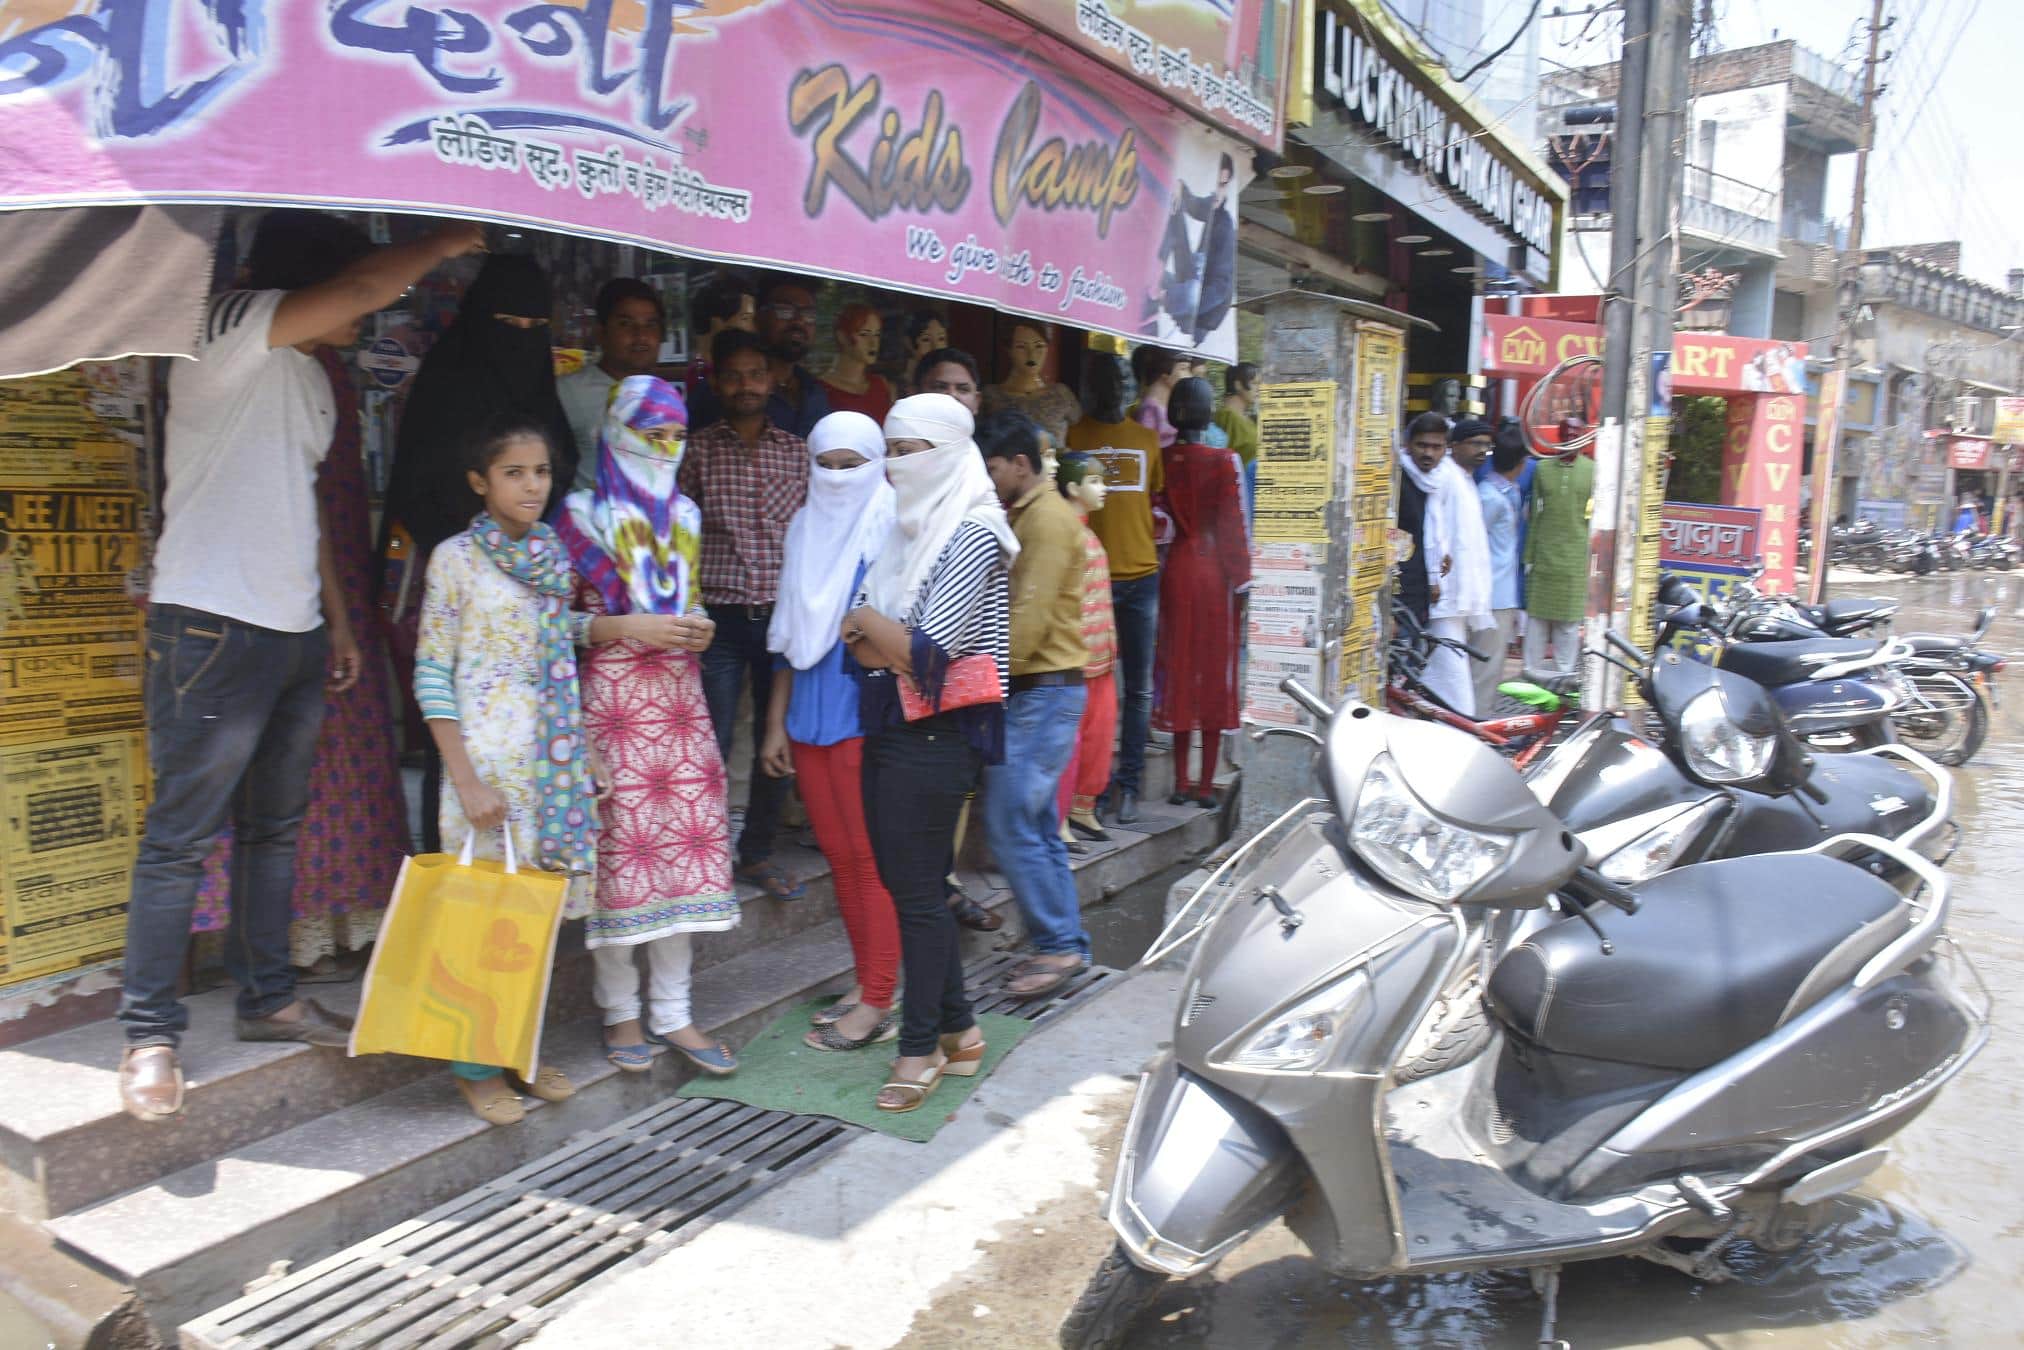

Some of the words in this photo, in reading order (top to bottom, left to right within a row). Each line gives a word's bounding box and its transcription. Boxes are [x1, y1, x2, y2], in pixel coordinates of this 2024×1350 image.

[790, 62, 971, 221] Kids
[1323, 10, 1446, 175] LUCKNOW
[908, 228, 942, 261] We
[947, 236, 996, 282] give
[1041, 266, 1060, 290] to
[1672, 344, 1736, 379] ART
